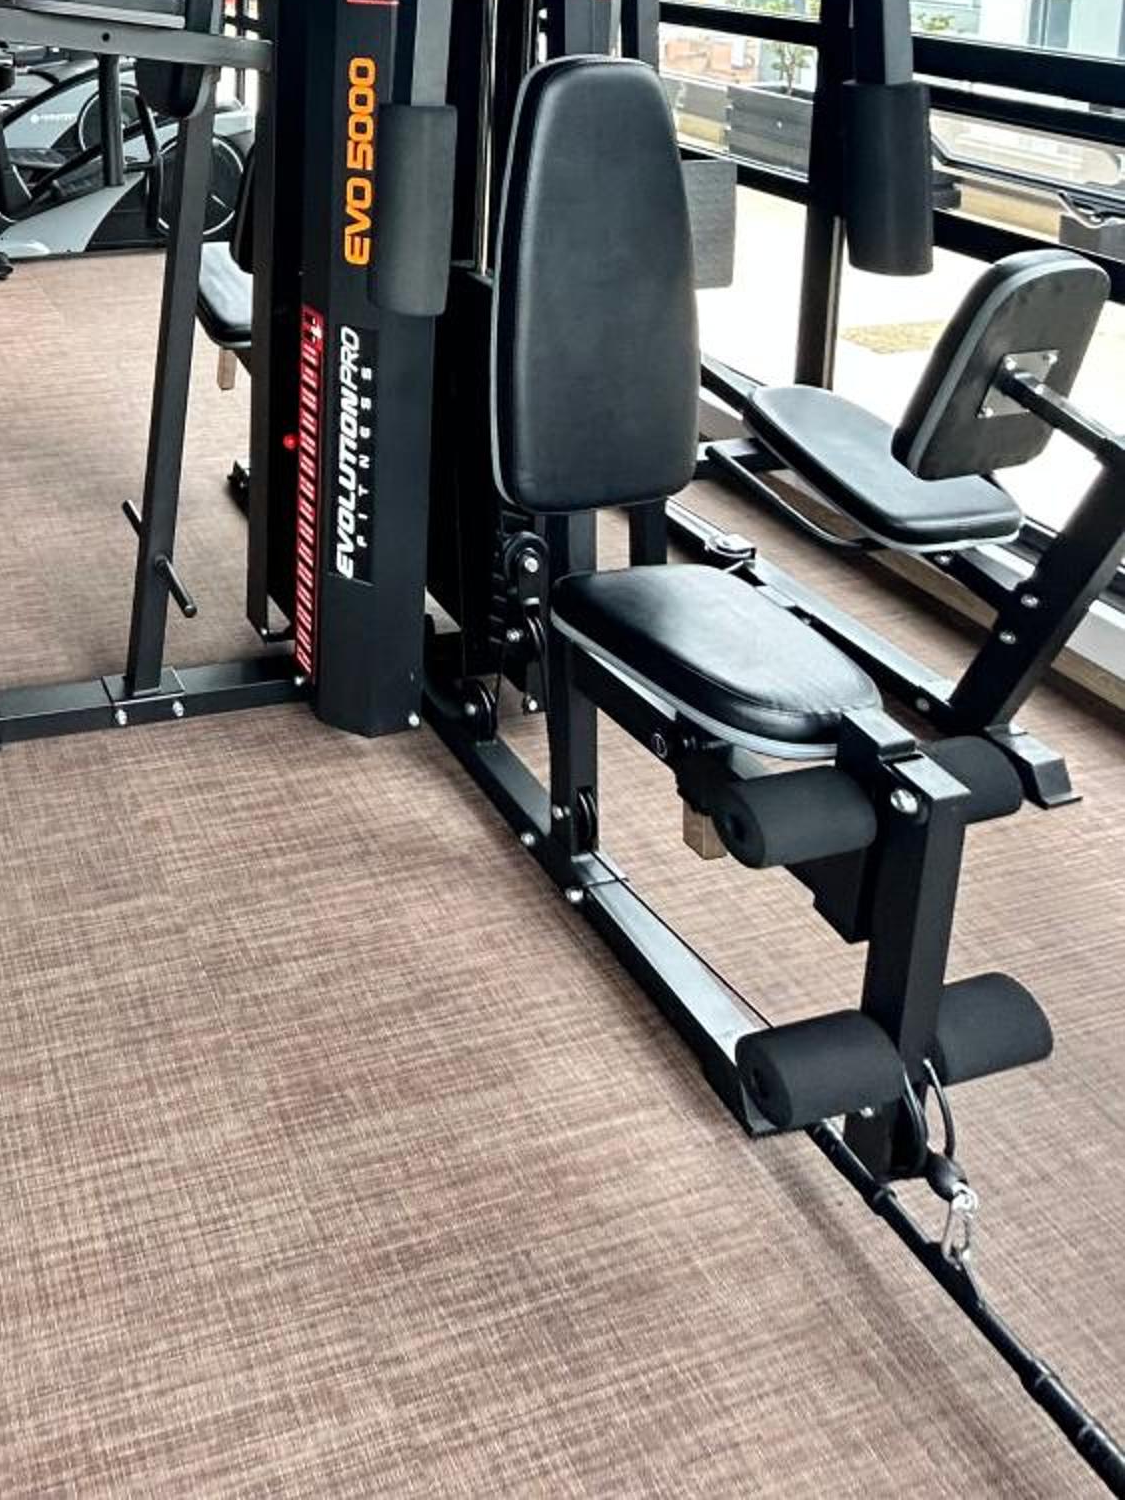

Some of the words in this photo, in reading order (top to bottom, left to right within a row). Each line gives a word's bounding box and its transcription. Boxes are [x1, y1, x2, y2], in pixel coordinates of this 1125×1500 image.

[347, 57, 376, 170] 5000
[344, 177, 373, 265] EVO
[357, 366, 373, 547] FITNESS
